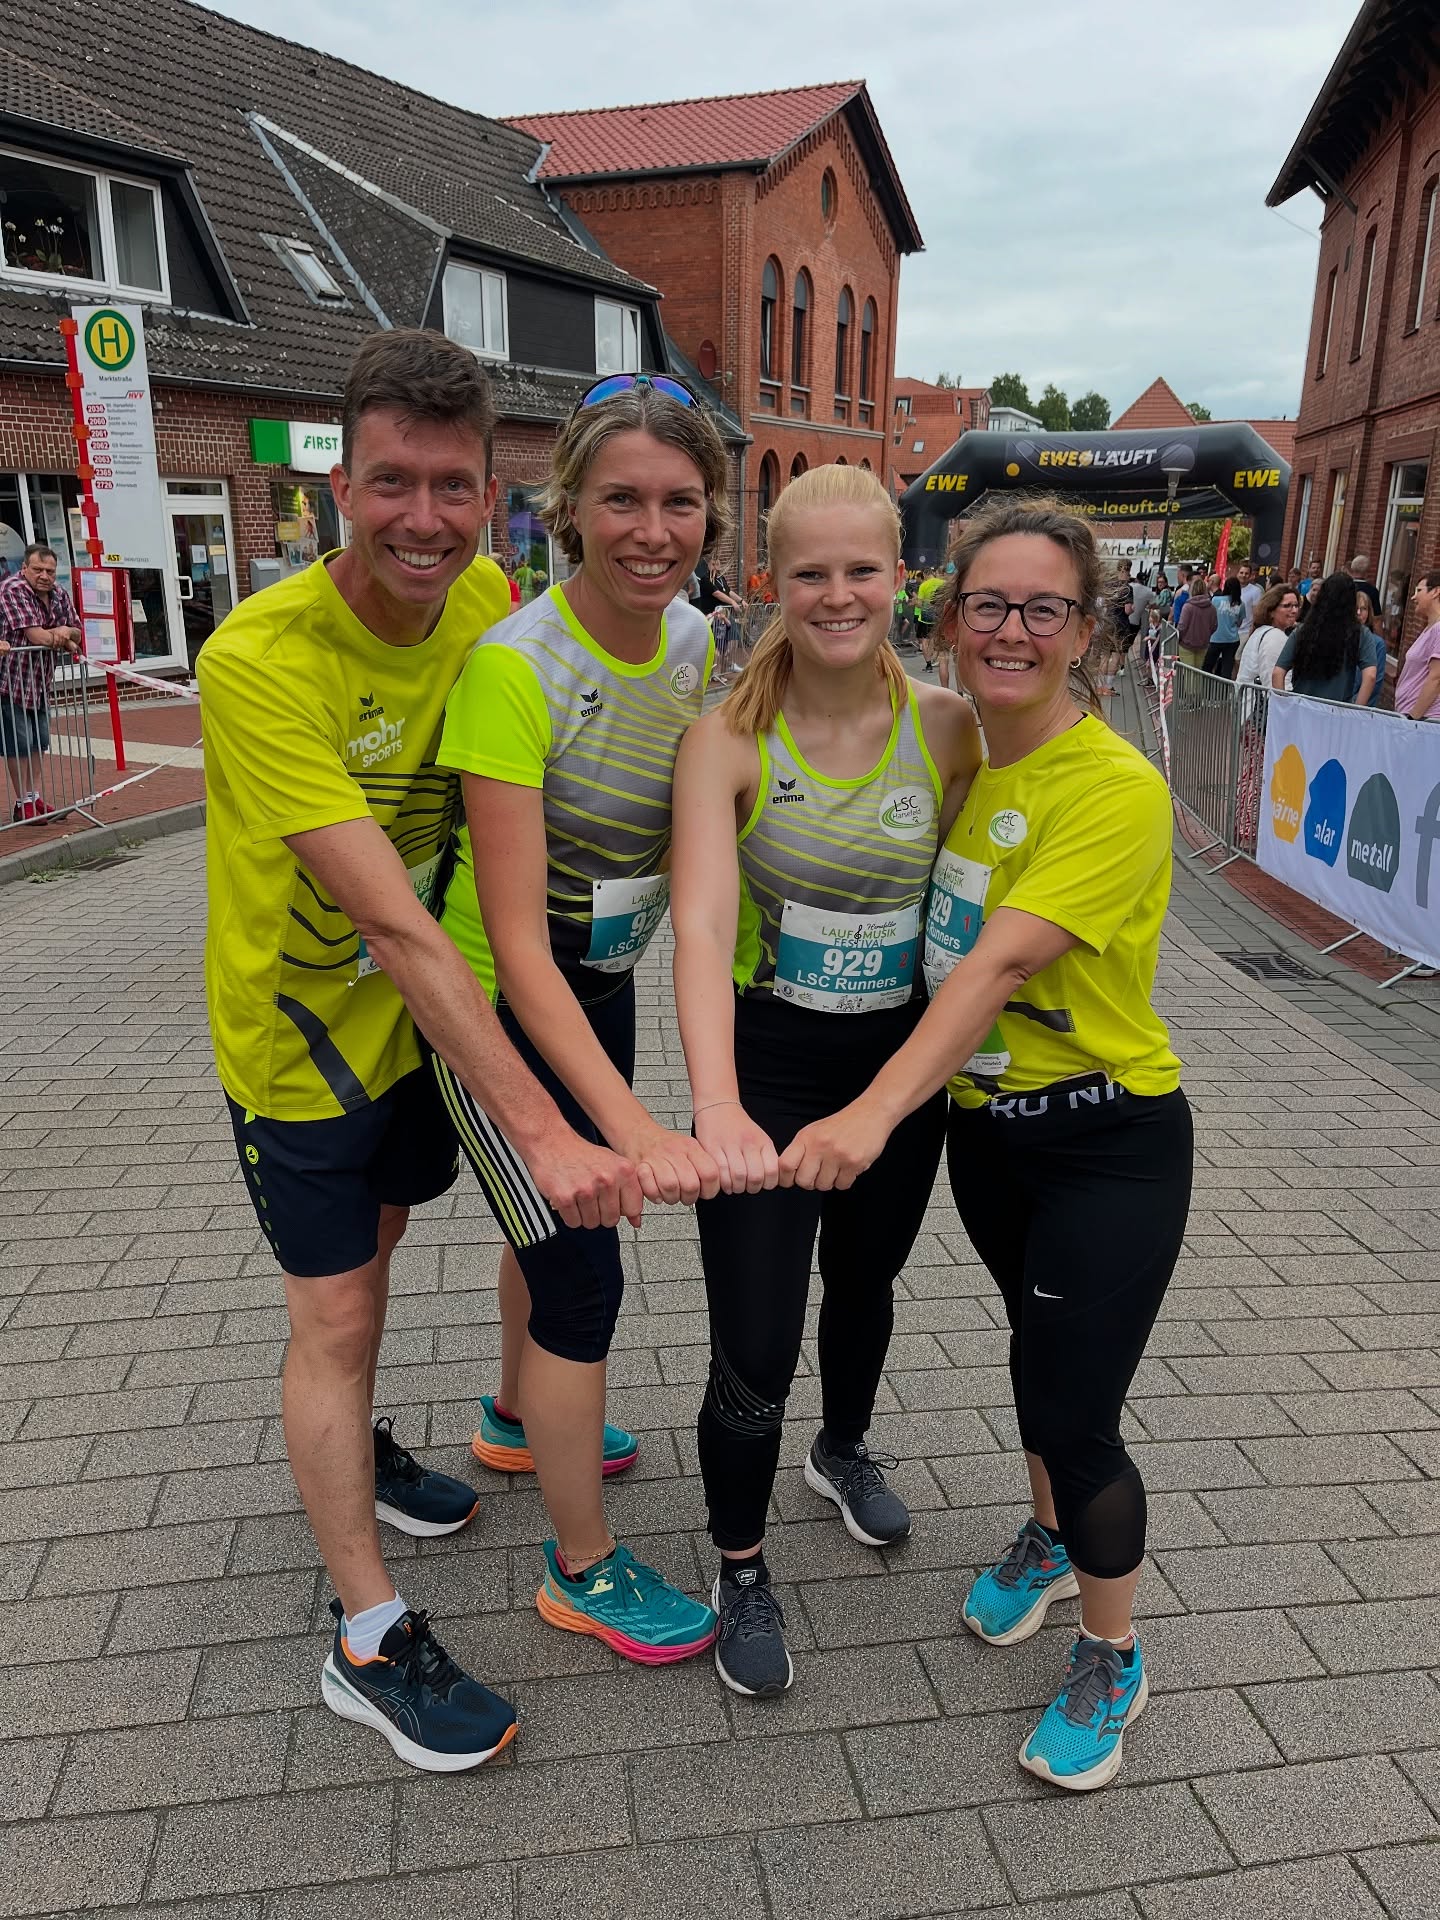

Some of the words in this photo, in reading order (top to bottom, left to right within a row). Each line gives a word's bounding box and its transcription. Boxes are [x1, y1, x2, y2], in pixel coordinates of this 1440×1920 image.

[98, 323, 122, 358] H
[303, 435, 338, 450] FIRST
[1038, 450, 1079, 467] EWE
[1093, 448, 1157, 466] LÄUFT
[925, 474, 968, 491] EWE
[1233, 469, 1281, 488] EWE
[107, 554, 120, 562] AST
[358, 706, 385, 722] erima
[345, 717, 406, 761] mohr
[362, 739, 403, 768] SPORTS
[772, 793, 805, 804] erima
[893, 795, 919, 812] LSC
[1350, 838, 1393, 873] metall
[930, 888, 953, 927] 929
[821, 926, 854, 940] LAUF
[863, 928, 898, 940] MUSIK
[964, 915, 971, 933] 1
[608, 938, 636, 957] LSC
[822, 948, 883, 977] 929
[899, 952, 909, 969] 2
[796, 969, 831, 988] LSC
[834, 976, 898, 991] Runners
